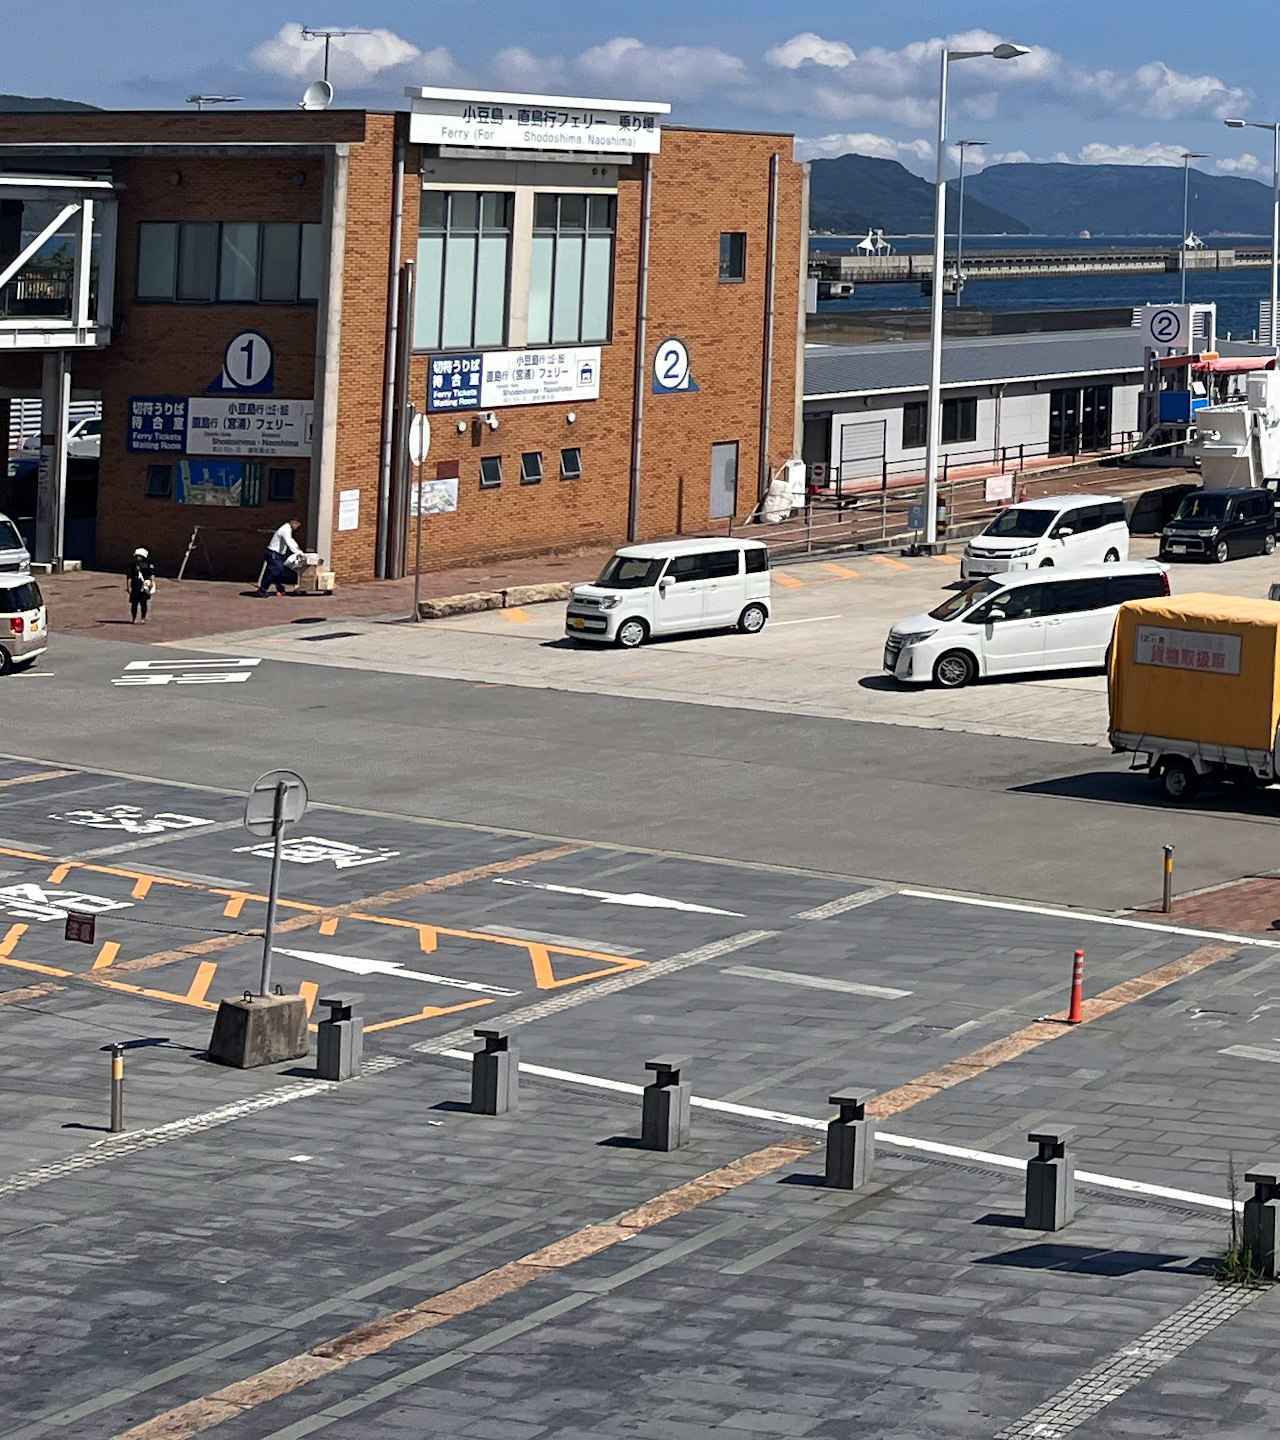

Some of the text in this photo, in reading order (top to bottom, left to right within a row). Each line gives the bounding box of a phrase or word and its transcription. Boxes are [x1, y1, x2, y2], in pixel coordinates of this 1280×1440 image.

[463, 105, 655, 133] 小豆島・直島行フェリー 乗り場
[441, 127, 469, 140] Ferry
[474, 128, 495, 141] (For
[588, 134, 636, 148] Naoshima)
[240, 339, 254, 380] 1
[433, 359, 480, 374] 切符うりば
[663, 349, 680, 379] 2
[433, 388, 477, 399] Ferry Tickets
[132, 401, 185, 416] 切符うりば
[433, 397, 478, 408] Waiting Room
[132, 431, 182, 441] Ferry Tickets
[132, 441, 182, 450] Waiting Room
[1150, 644, 1226, 669] 貨物取扱車
